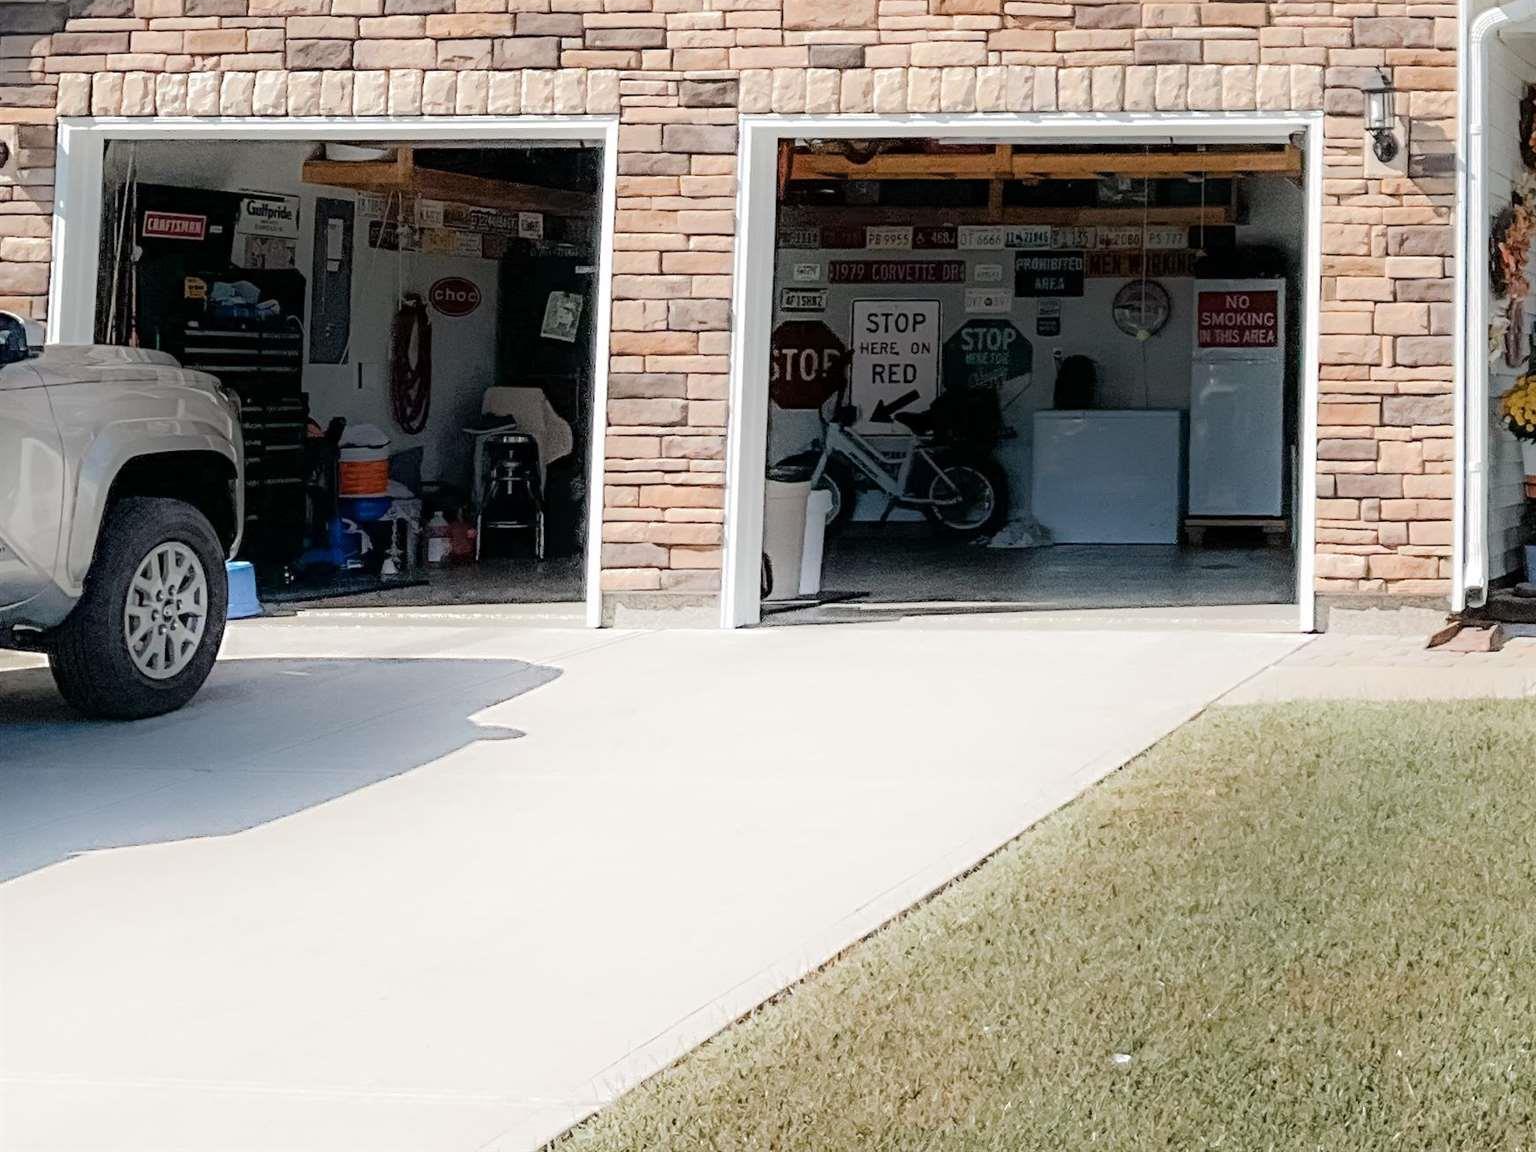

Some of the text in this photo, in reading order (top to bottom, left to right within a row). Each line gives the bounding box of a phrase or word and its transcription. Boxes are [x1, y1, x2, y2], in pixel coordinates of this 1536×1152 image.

[146, 218, 202, 235] CRAFTSMAN
[1016, 257, 1083, 272] PROHIBITED
[834, 264, 865, 282] 1979
[872, 263, 936, 282] CORVETTE
[942, 263, 959, 281] DR
[1034, 276, 1065, 290] AREA
[1225, 295, 1250, 309] NO
[866, 313, 926, 333] STOP
[1201, 312, 1274, 326] SMOKING
[960, 327, 1017, 351] STOP
[1200, 329, 1275, 343] IN THIS AREA
[860, 342, 931, 355] HERE ON
[872, 363, 918, 384] RED
